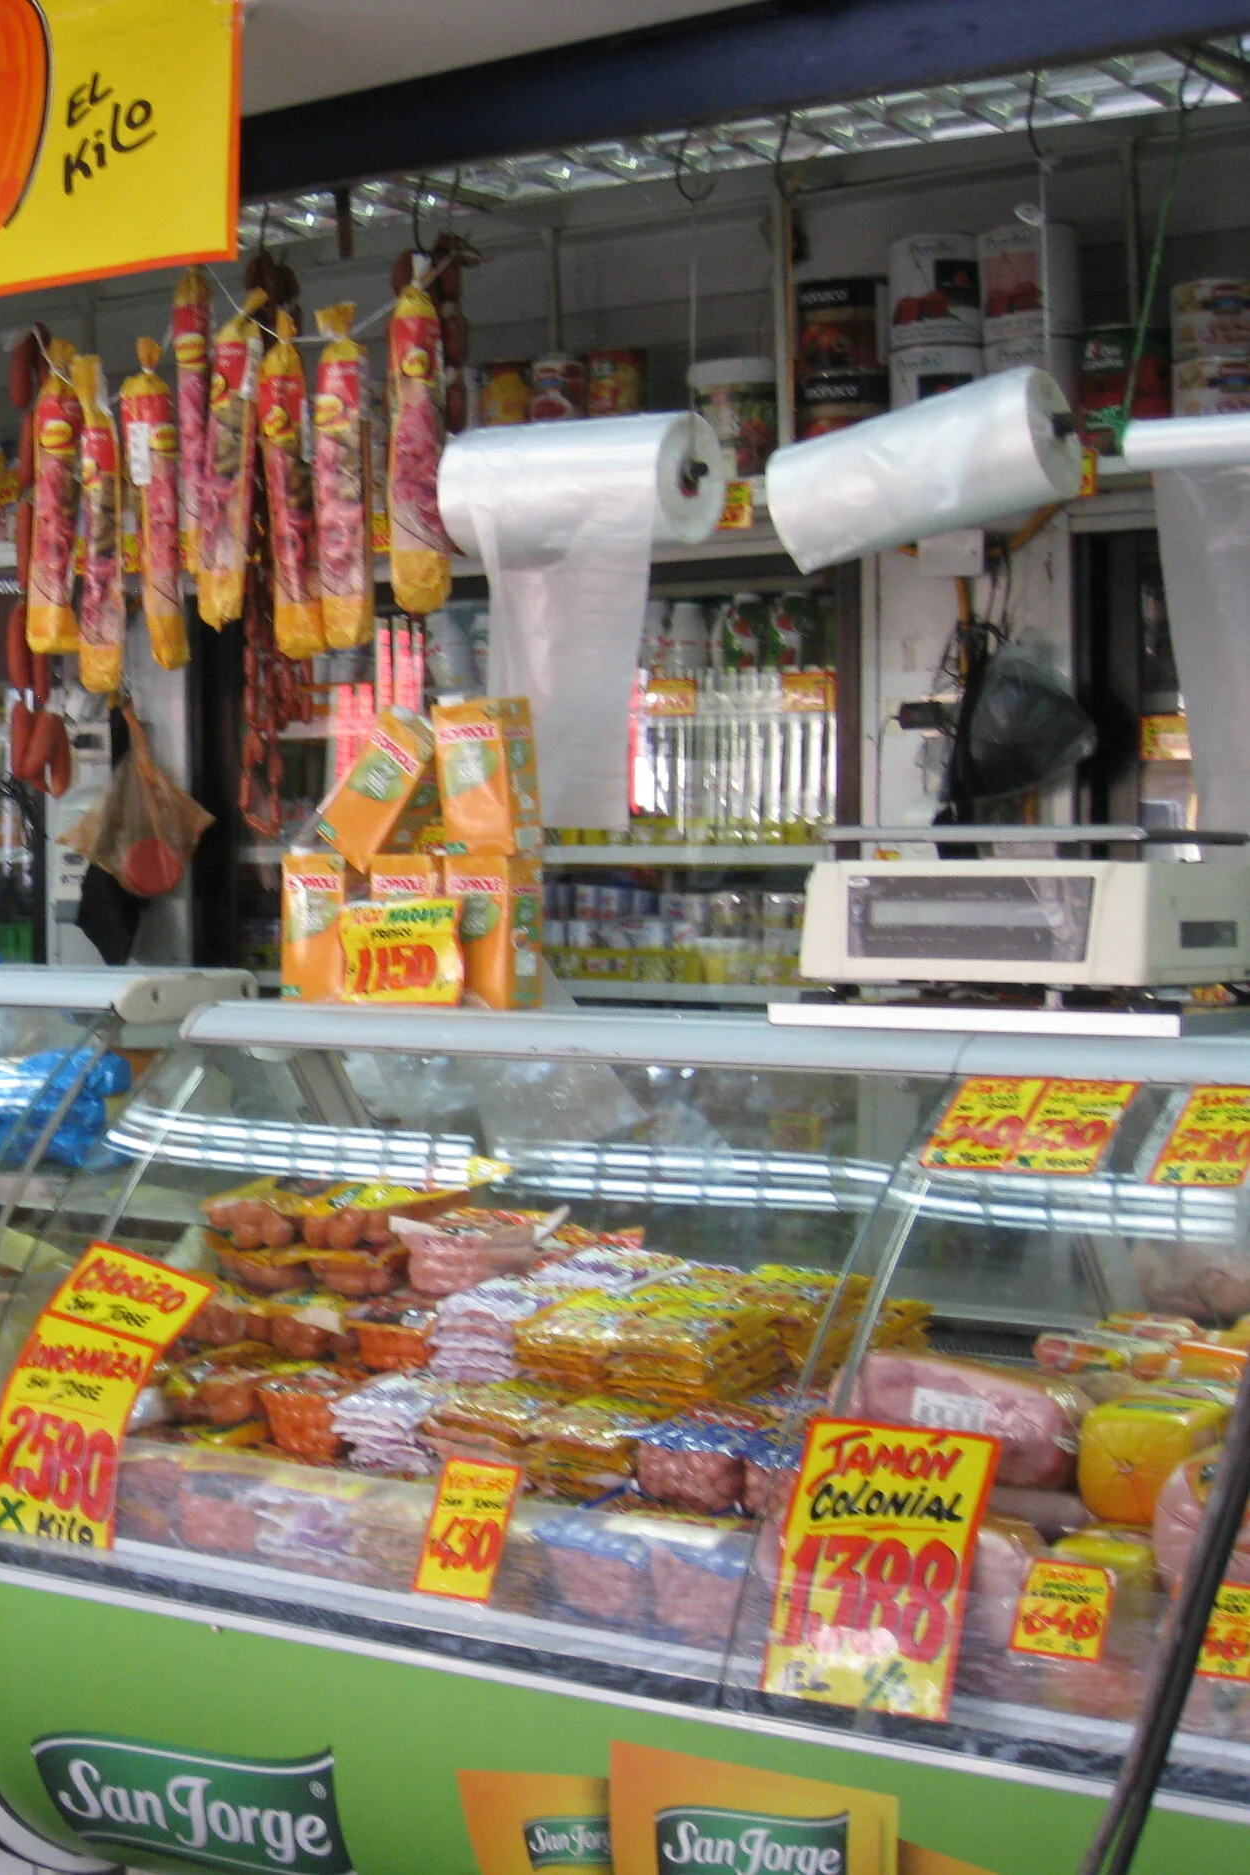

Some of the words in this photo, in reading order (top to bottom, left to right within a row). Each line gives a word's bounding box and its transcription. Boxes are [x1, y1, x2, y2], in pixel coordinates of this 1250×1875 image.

[66, 70, 113, 129] EL
[58, 1758, 171, 1832] San
[166, 1774, 333, 1865] Jorge
[527, 1824, 572, 1854] San
[661, 1819, 737, 1867] San
[735, 1827, 842, 1875] Jorge
